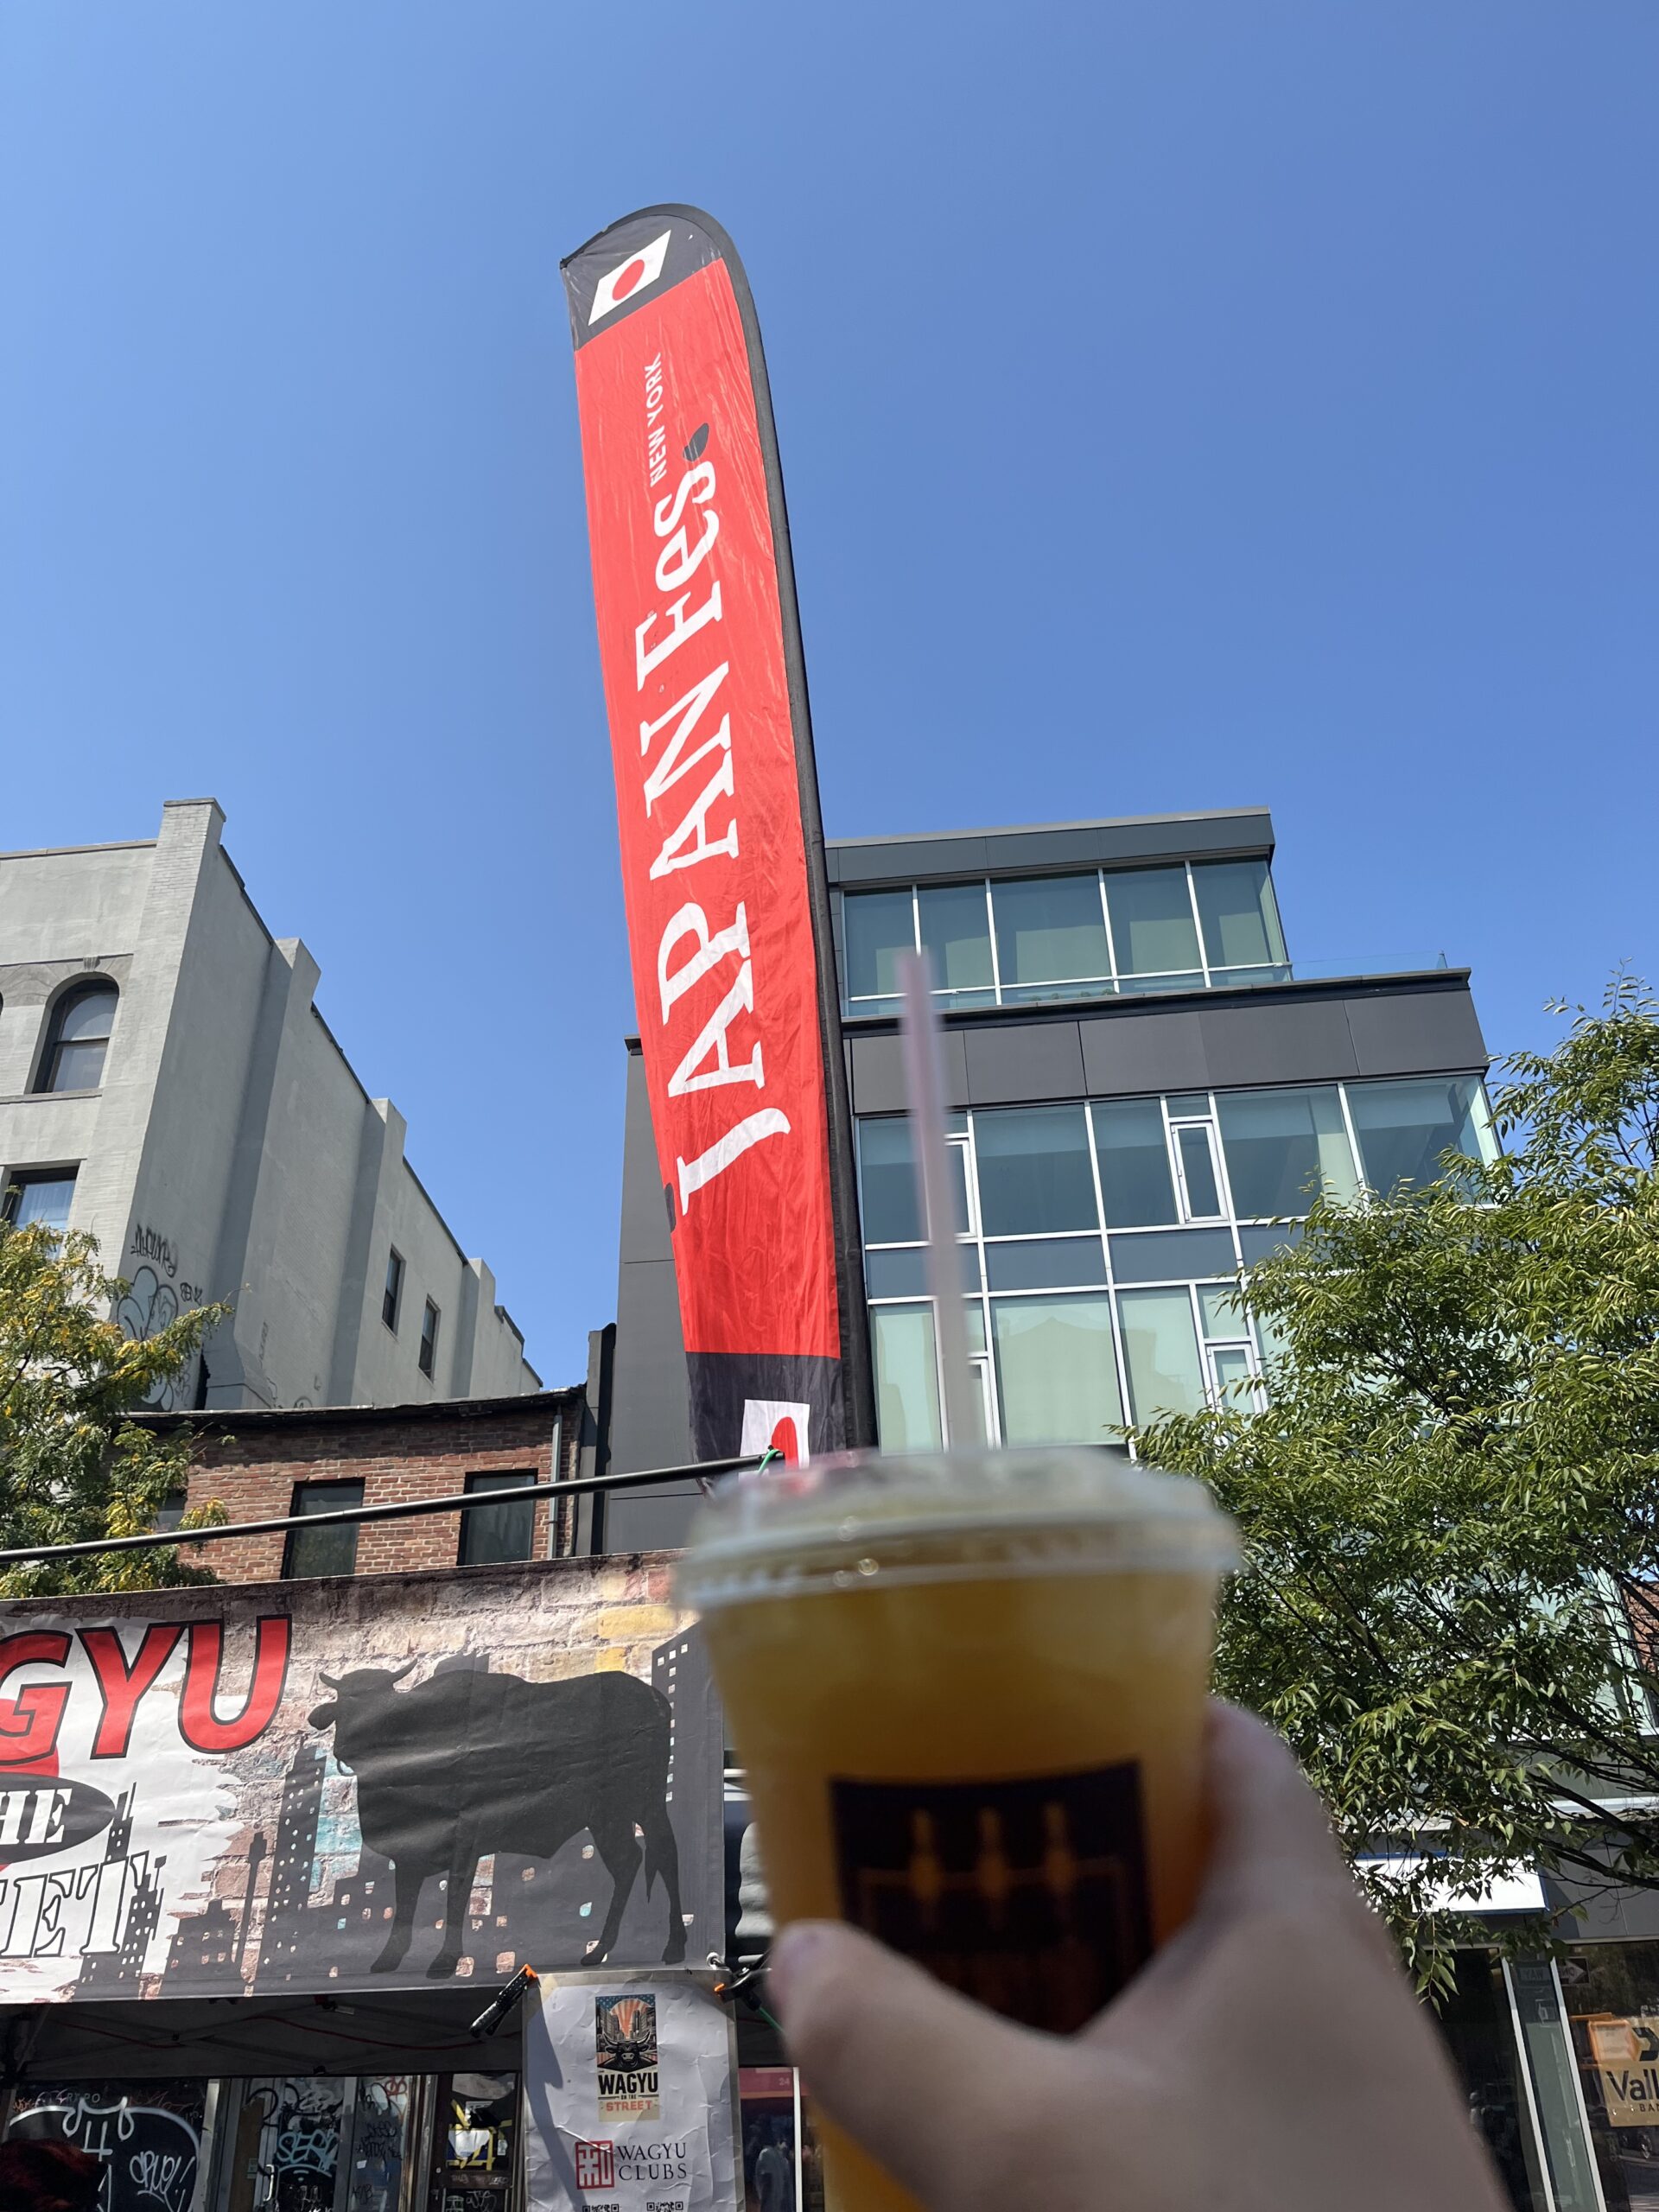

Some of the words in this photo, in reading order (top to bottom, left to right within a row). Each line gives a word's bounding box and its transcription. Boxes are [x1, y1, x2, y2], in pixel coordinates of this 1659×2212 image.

[644, 352, 664, 428] YORK
[648, 425, 667, 487] NEW
[598, 2072, 658, 2095] WAGYU
[779, 2077, 790, 2086] 24
[606, 2101, 652, 2112] STREET
[617, 2142, 687, 2161] WAGYU
[618, 2163, 687, 2181] CLUBS
